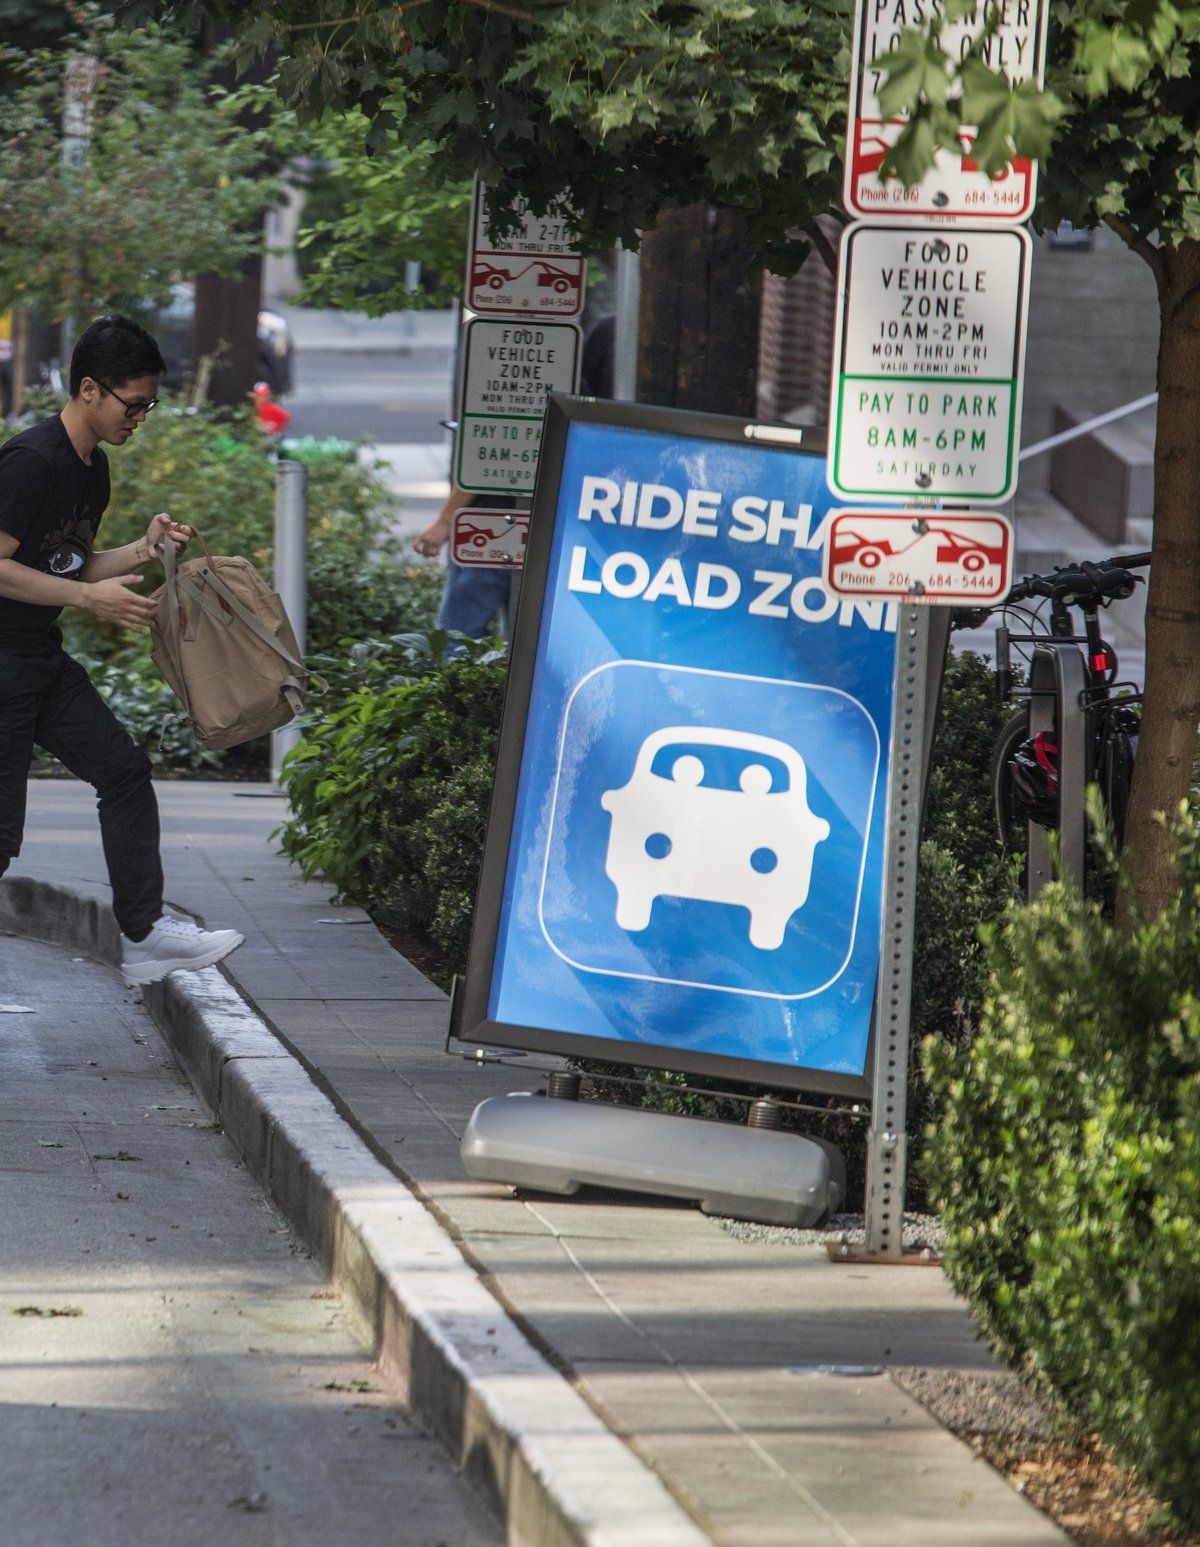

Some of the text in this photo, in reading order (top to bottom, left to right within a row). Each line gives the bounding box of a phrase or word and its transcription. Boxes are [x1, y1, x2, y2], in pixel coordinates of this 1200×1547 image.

[960, 34, 1028, 65] ONLY
[861, 187, 1020, 204] Phone (206) 684-5444
[519, 243, 543, 252] THRU
[548, 244, 564, 252] FRI
[904, 240, 969, 263] FOOD
[882, 268, 987, 293] VEHICLE
[901, 296, 965, 319] ZONE
[503, 330, 544, 345] FOOD
[880, 321, 985, 341] 10AM-2PM
[488, 347, 555, 363] VEHICLE
[872, 344, 987, 360] MON THRU FRI
[501, 364, 542, 380] ZONE
[880, 363, 979, 374] VALID PERMIT ONLY
[487, 380, 553, 393] 10AM-2PM
[482, 394, 502, 403] MON
[509, 395, 534, 404] THRU
[858, 391, 997, 417] PAY TO PARK
[473, 424, 496, 438] PAY
[503, 426, 518, 440] TO
[867, 426, 986, 451] 8AM-6PM
[478, 446, 539, 463] 8AM-6P
[483, 468, 534, 480] SATURD
[877, 460, 977, 478] SATURDAY
[578, 475, 722, 538] RIDE
[568, 545, 741, 610] LOAD
[841, 571, 875, 585] Phone
[929, 574, 994, 588] 684-5444
